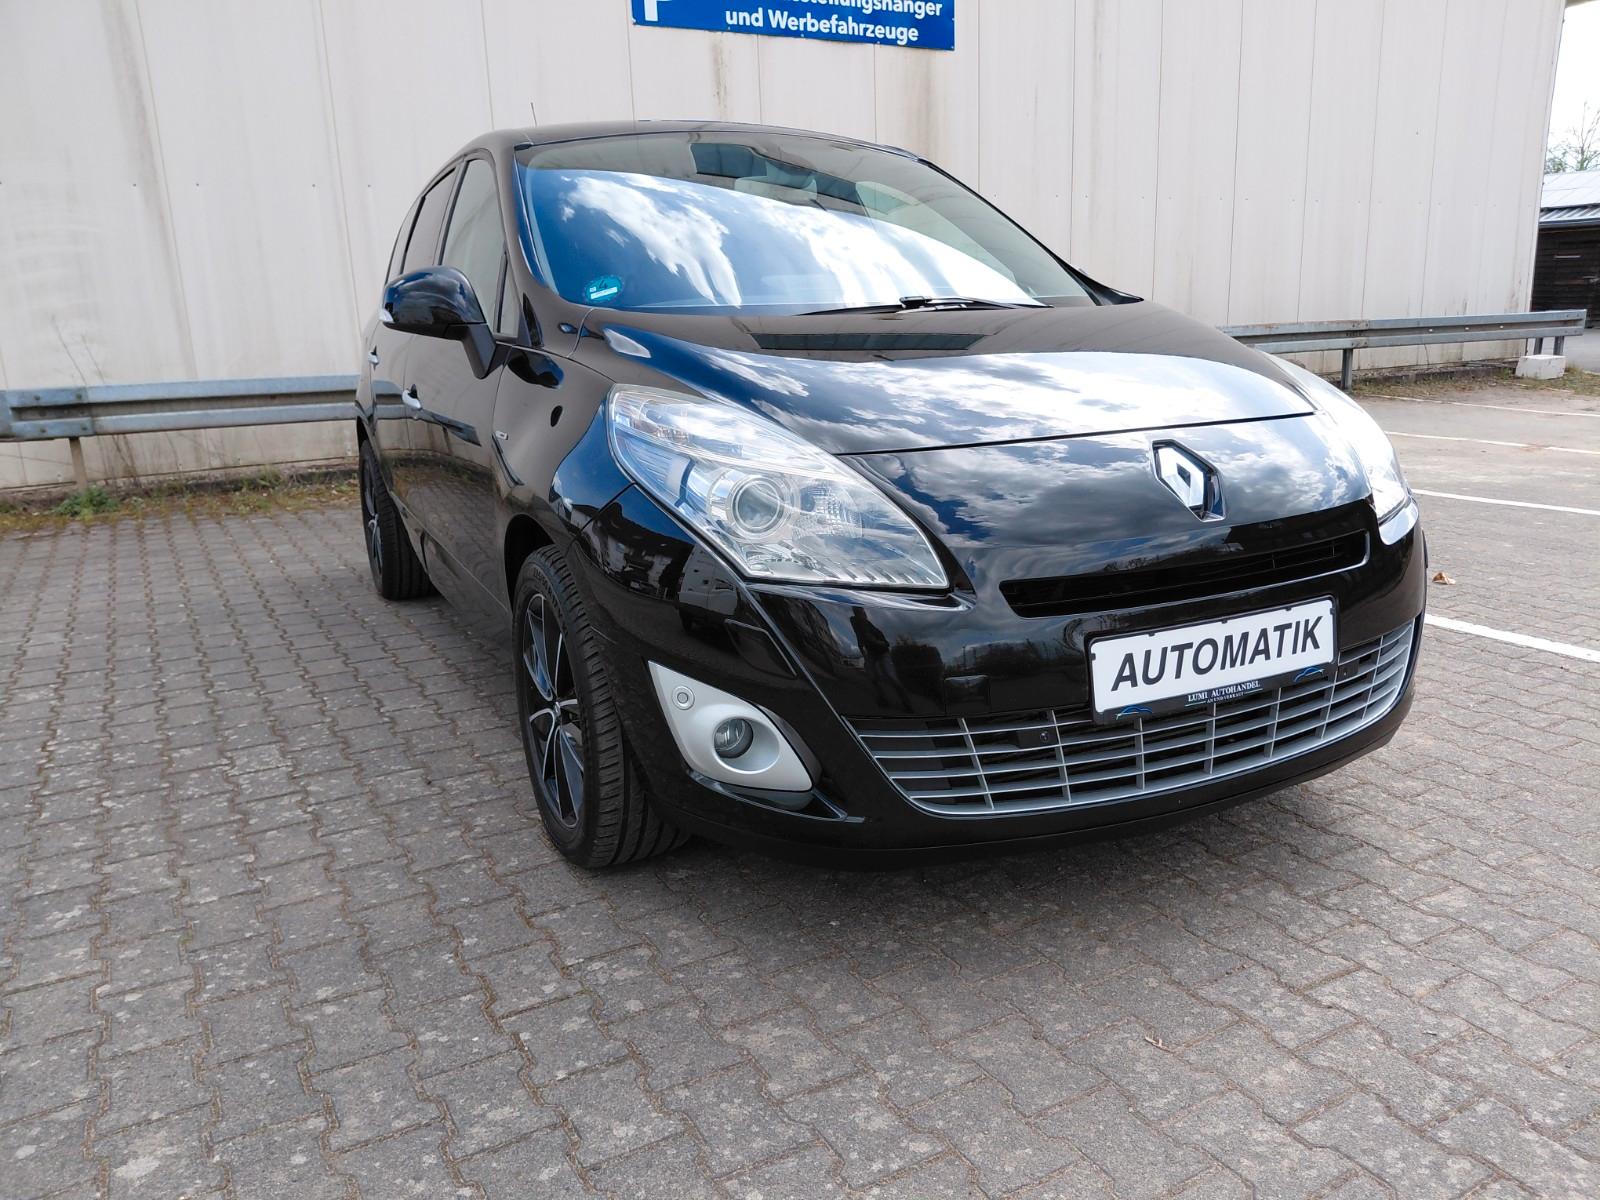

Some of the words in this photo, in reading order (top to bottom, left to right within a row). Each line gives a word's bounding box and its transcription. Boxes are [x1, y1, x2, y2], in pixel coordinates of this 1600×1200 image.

[725, 7, 763, 28] und
[768, 9, 919, 45] Werbefahrzeuge
[1111, 616, 1323, 692] AUTOMATIK
[1188, 691, 1208, 702] LUMI
[1211, 680, 1261, 697] AUTOHANDEL
